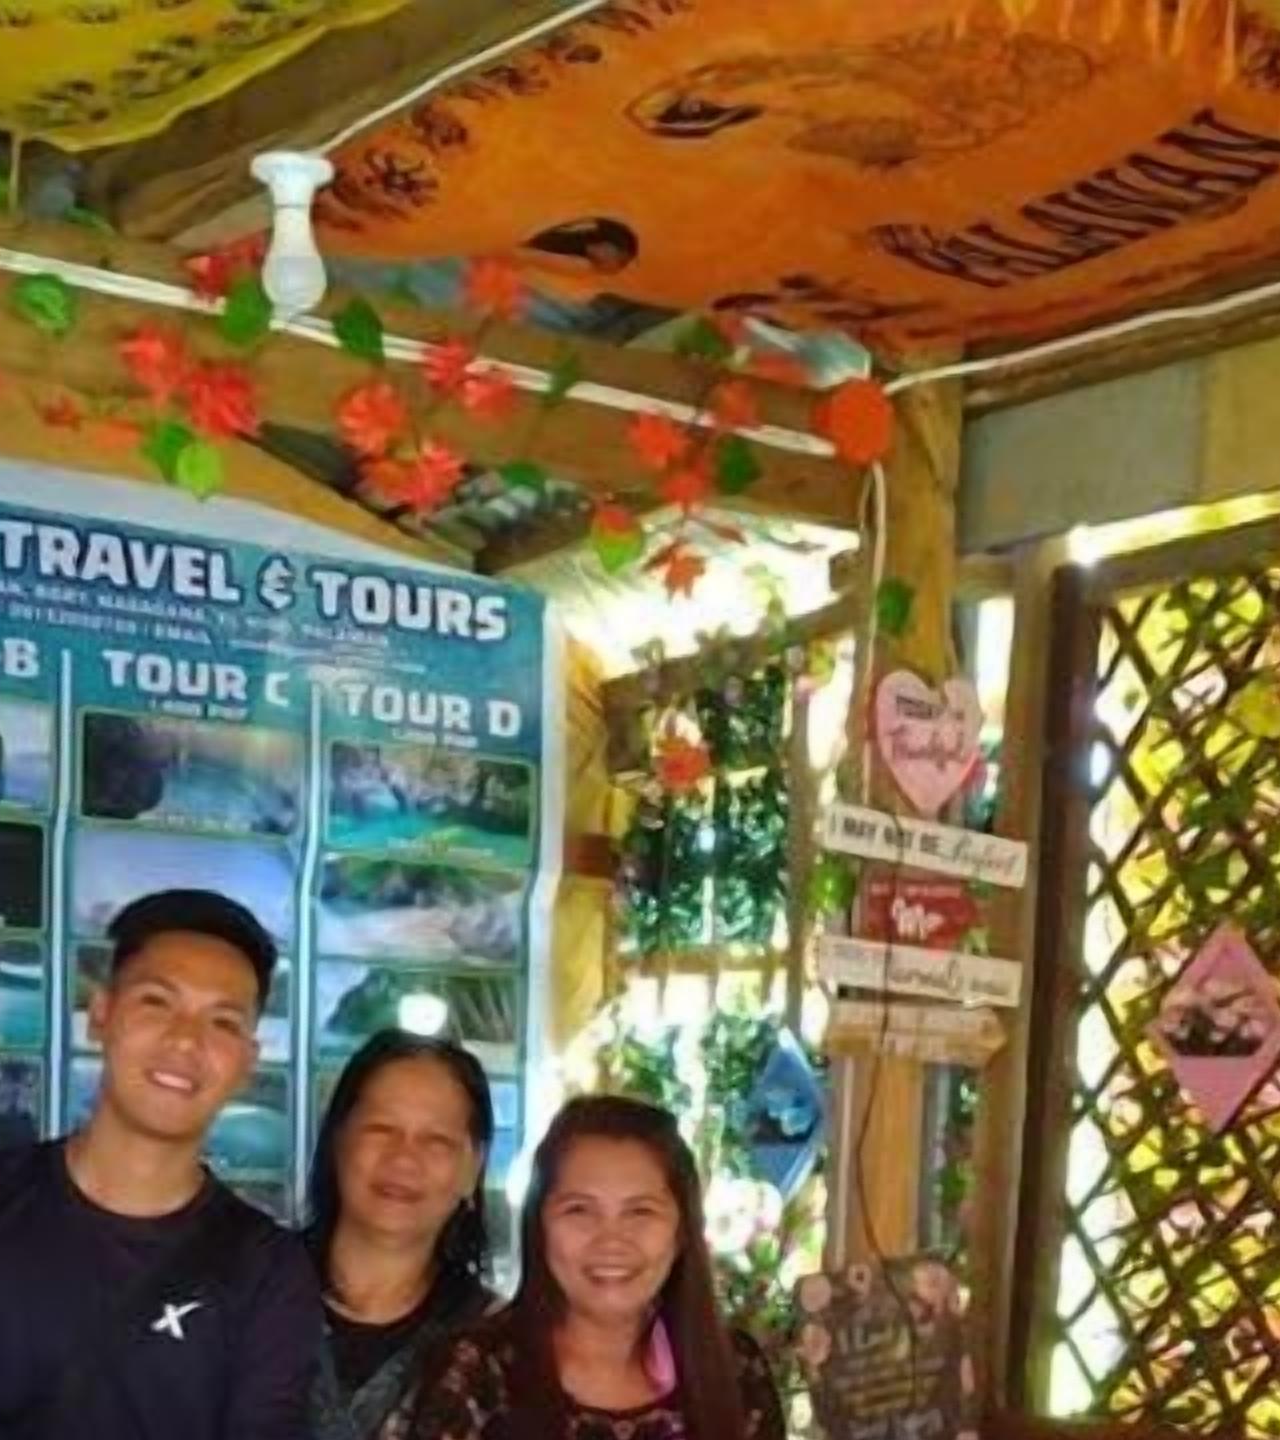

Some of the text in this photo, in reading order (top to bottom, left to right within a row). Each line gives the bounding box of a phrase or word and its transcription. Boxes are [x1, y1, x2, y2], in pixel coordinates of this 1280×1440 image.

[312, 568, 508, 642] TOURS
[2, 637, 40, 679] B
[103, 648, 248, 702] TOUR
[263, 671, 291, 708] C
[341, 682, 522, 739] TOUR D
